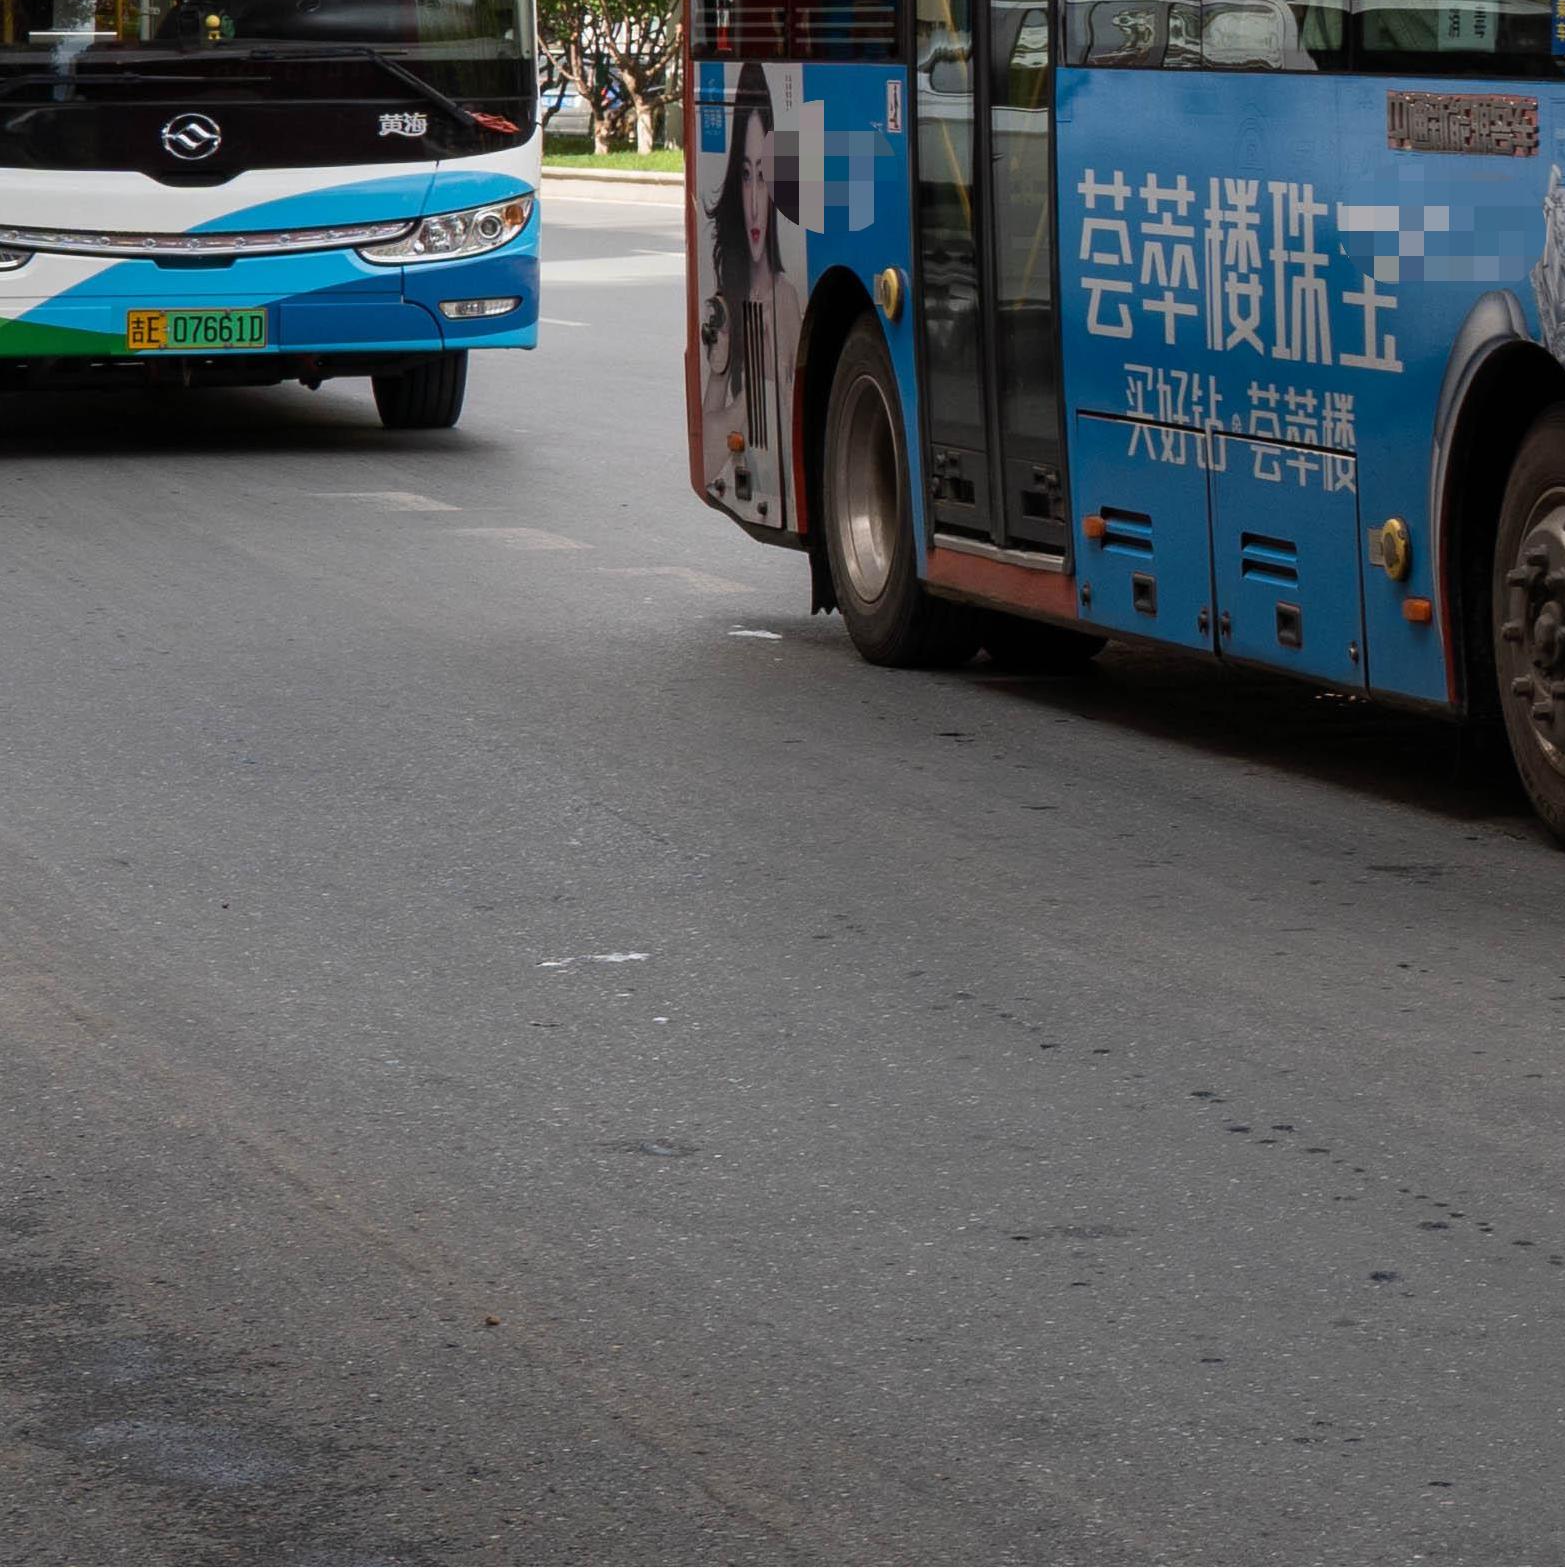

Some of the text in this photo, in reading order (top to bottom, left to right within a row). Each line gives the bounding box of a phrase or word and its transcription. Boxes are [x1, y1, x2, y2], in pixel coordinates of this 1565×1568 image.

[379, 112, 427, 136] 黄海
[1124, 363, 1357, 494] 买好钻 荟萃楼
